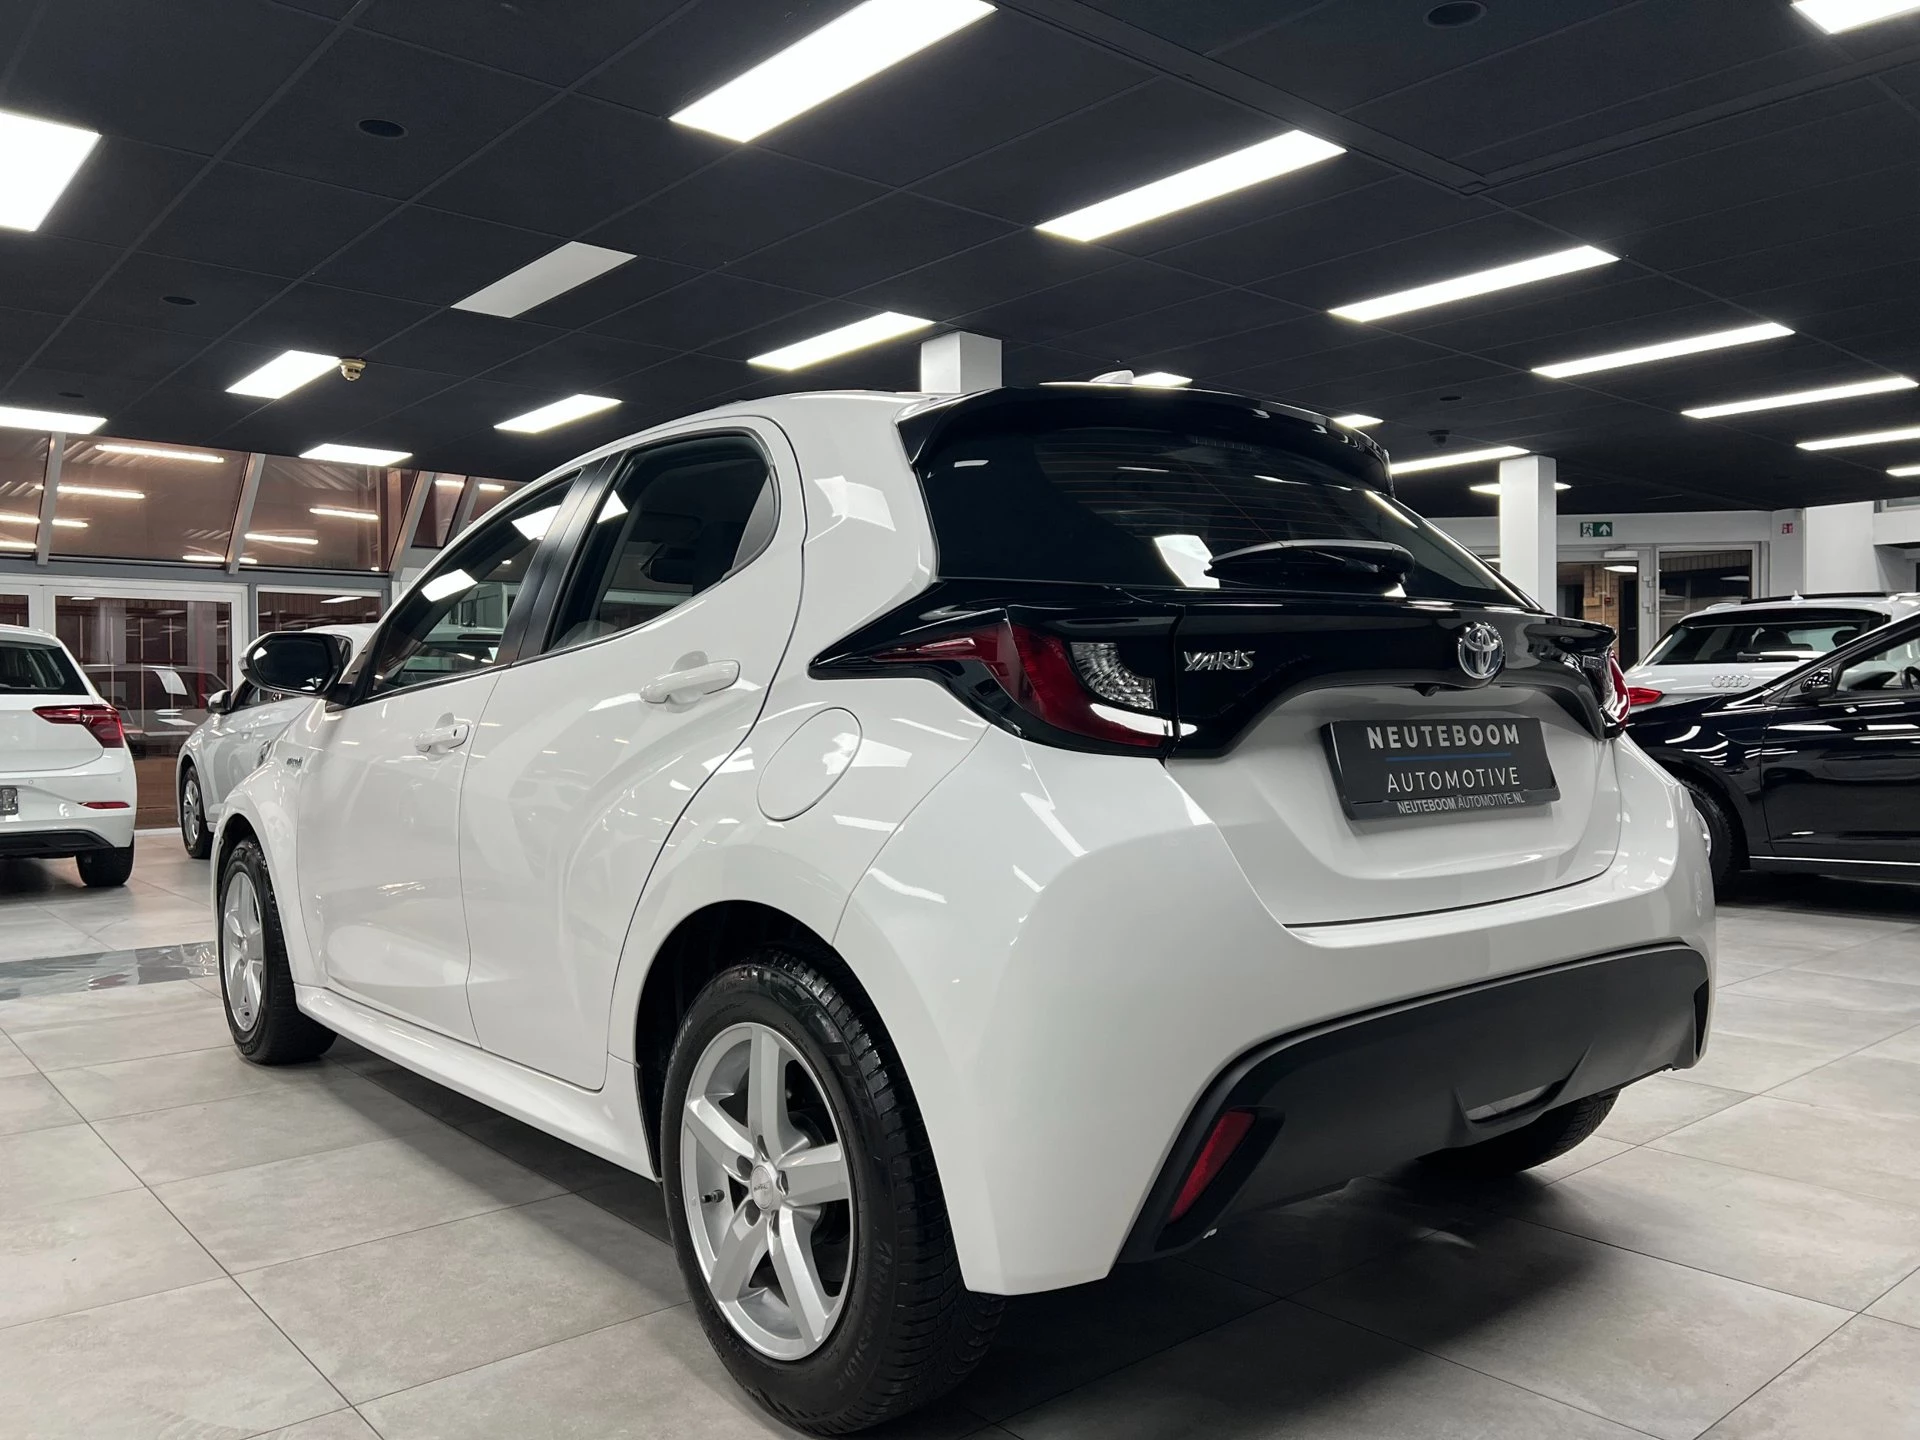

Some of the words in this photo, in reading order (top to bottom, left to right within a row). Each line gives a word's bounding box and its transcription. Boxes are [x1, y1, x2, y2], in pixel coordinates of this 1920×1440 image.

[1184, 650, 1256, 671] YARIS
[1366, 724, 1520, 749] NEUTEBOOM
[1387, 767, 1520, 793] AUTOMOTIVE
[1396, 797, 1457, 814] NEUTEBOOM
[1458, 793, 1526, 809] AUTOMOTIVE.NL
